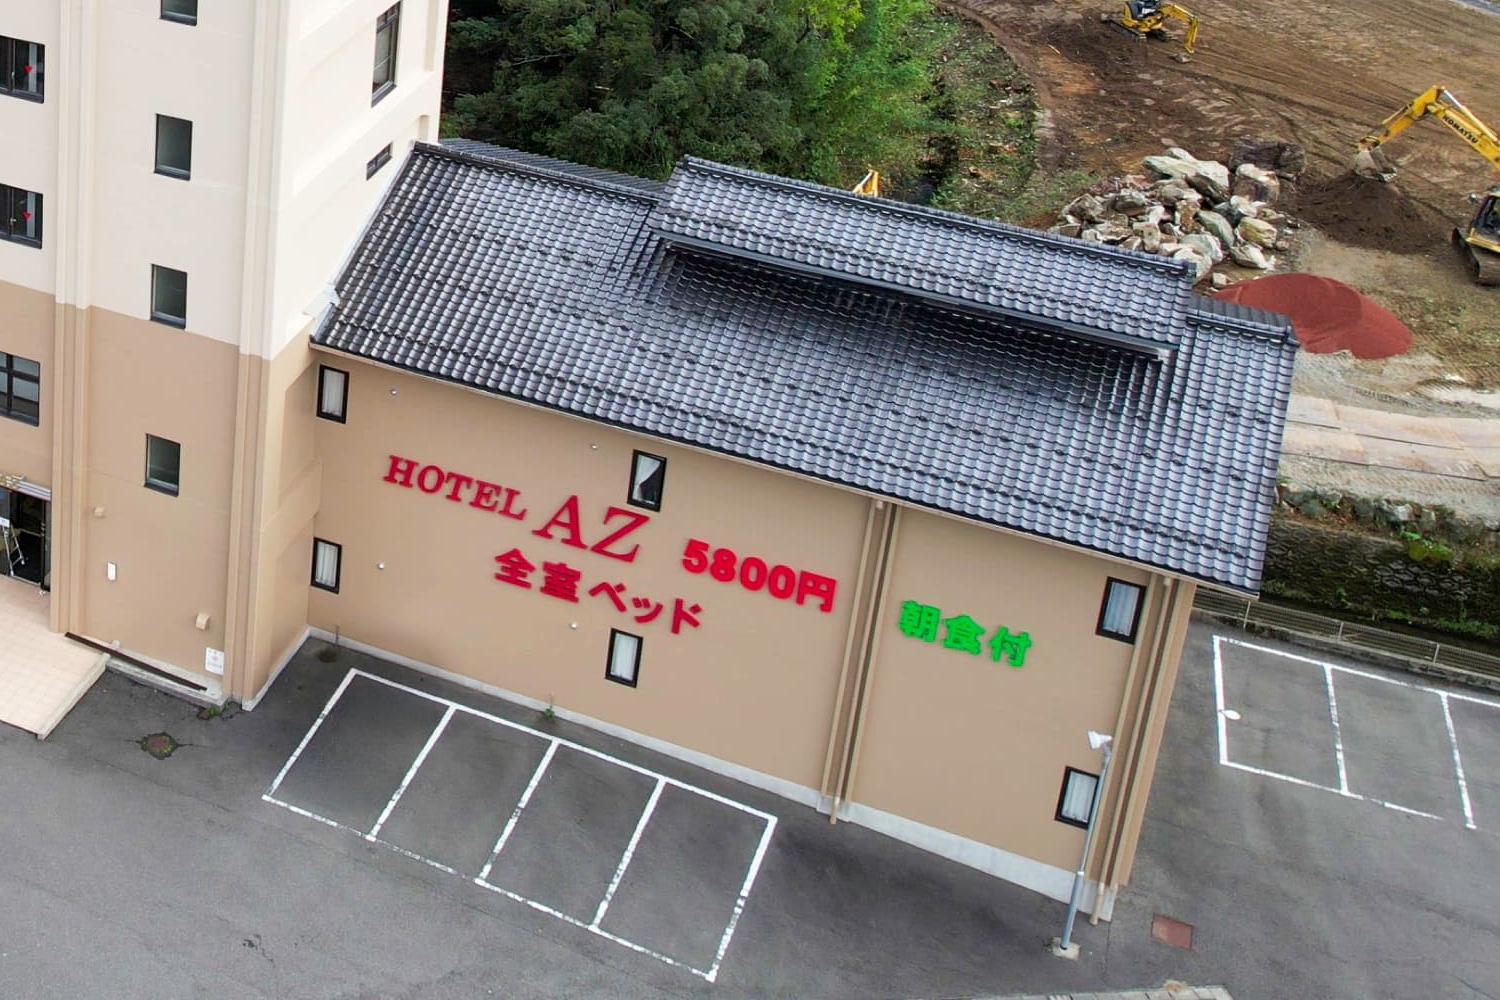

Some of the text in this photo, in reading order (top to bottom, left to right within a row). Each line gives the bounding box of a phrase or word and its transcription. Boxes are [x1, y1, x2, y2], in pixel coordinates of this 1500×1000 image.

[383, 454, 651, 564] HOTEL AZ
[681, 538, 838, 614] 5800円
[898, 600, 1033, 669] 朝食付
